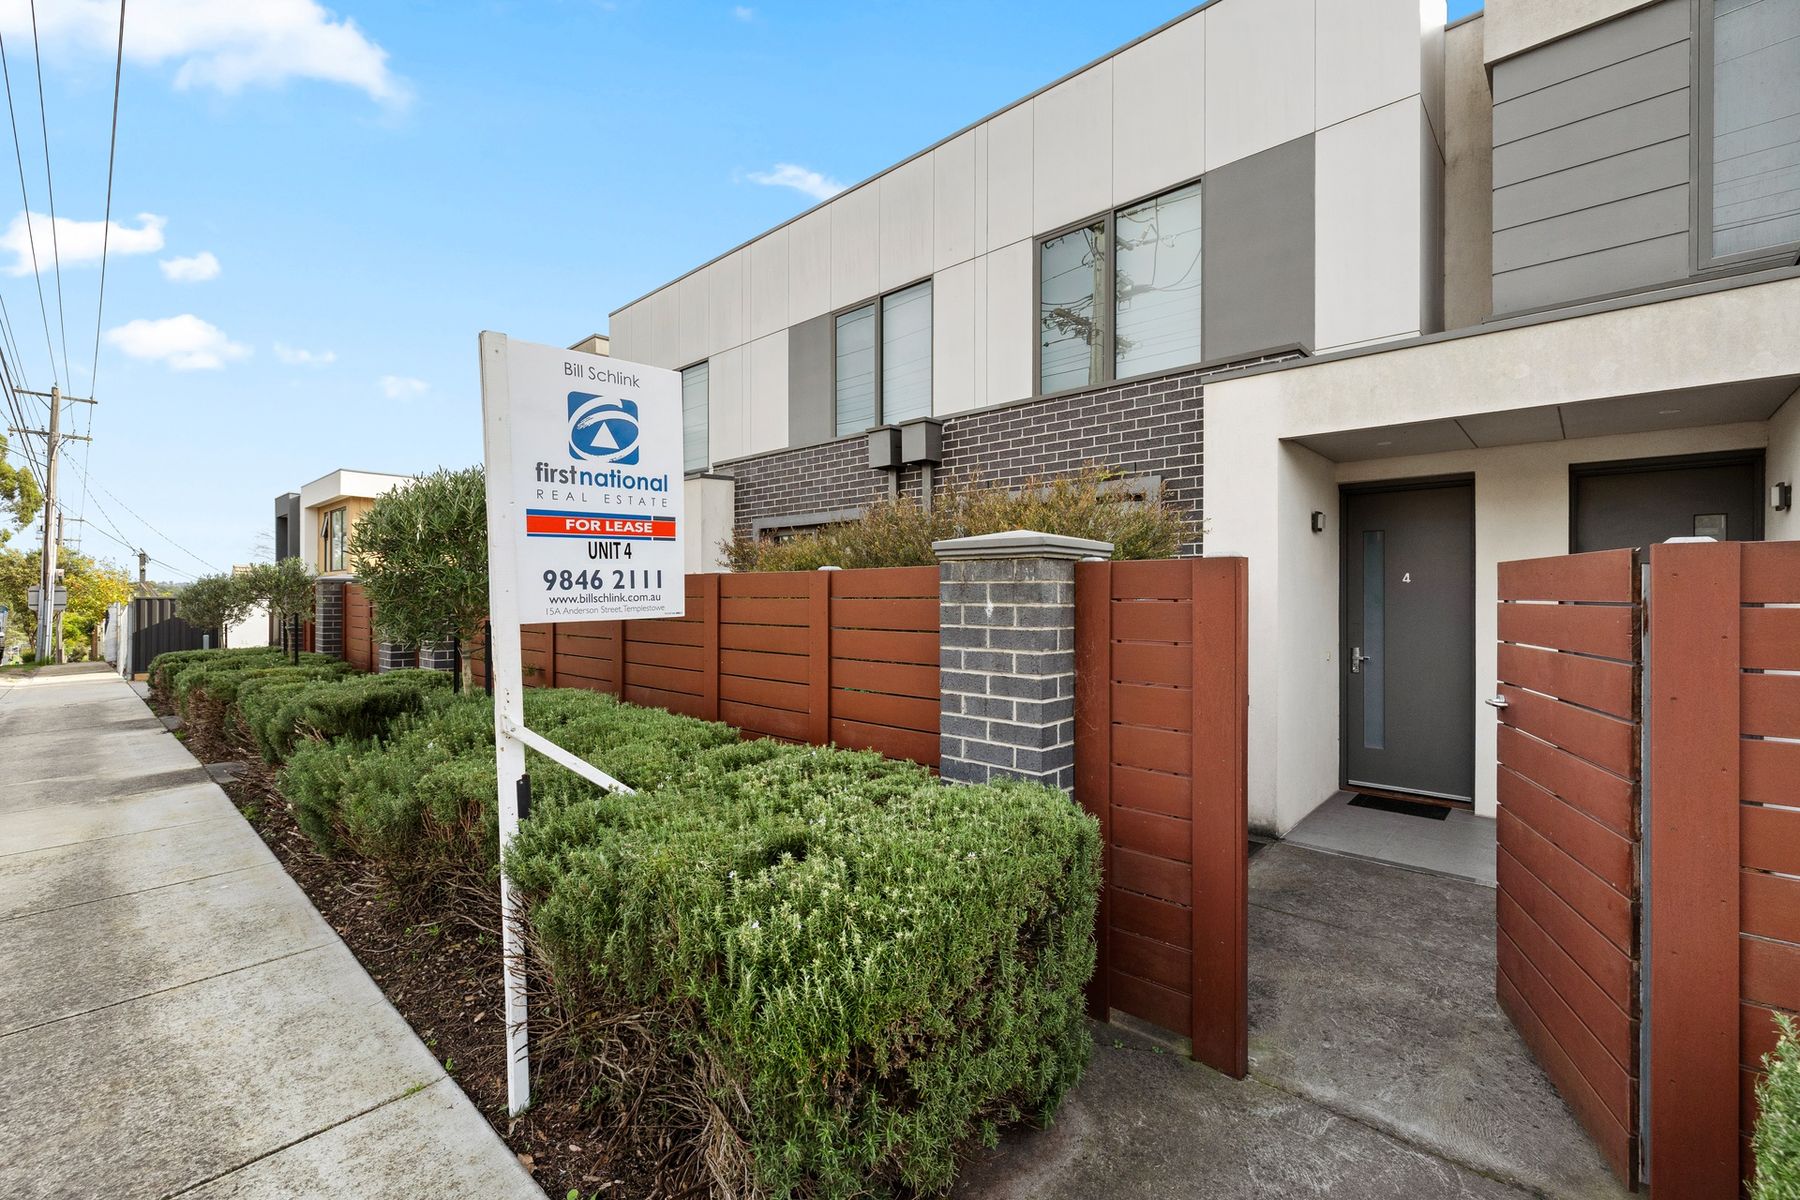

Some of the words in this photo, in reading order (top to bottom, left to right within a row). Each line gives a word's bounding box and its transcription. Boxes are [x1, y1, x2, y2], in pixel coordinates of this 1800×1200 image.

[564, 362, 583, 377] Bill
[588, 366, 640, 388] Schlink
[536, 488, 588, 502] REAL
[604, 493, 668, 507] ESTATE
[565, 519, 601, 531] FOR
[605, 520, 653, 533] LEASE
[588, 541, 621, 559] UNIT
[624, 543, 632, 559] 4
[543, 569, 603, 591] 9846
[612, 569, 662, 590] 2111
[1402, 572, 1411, 584] 4
[549, 592, 661, 604] www.billschlink.com.au
[562, 606, 599, 615] Anderson
[623, 604, 665, 613] Templestowe
